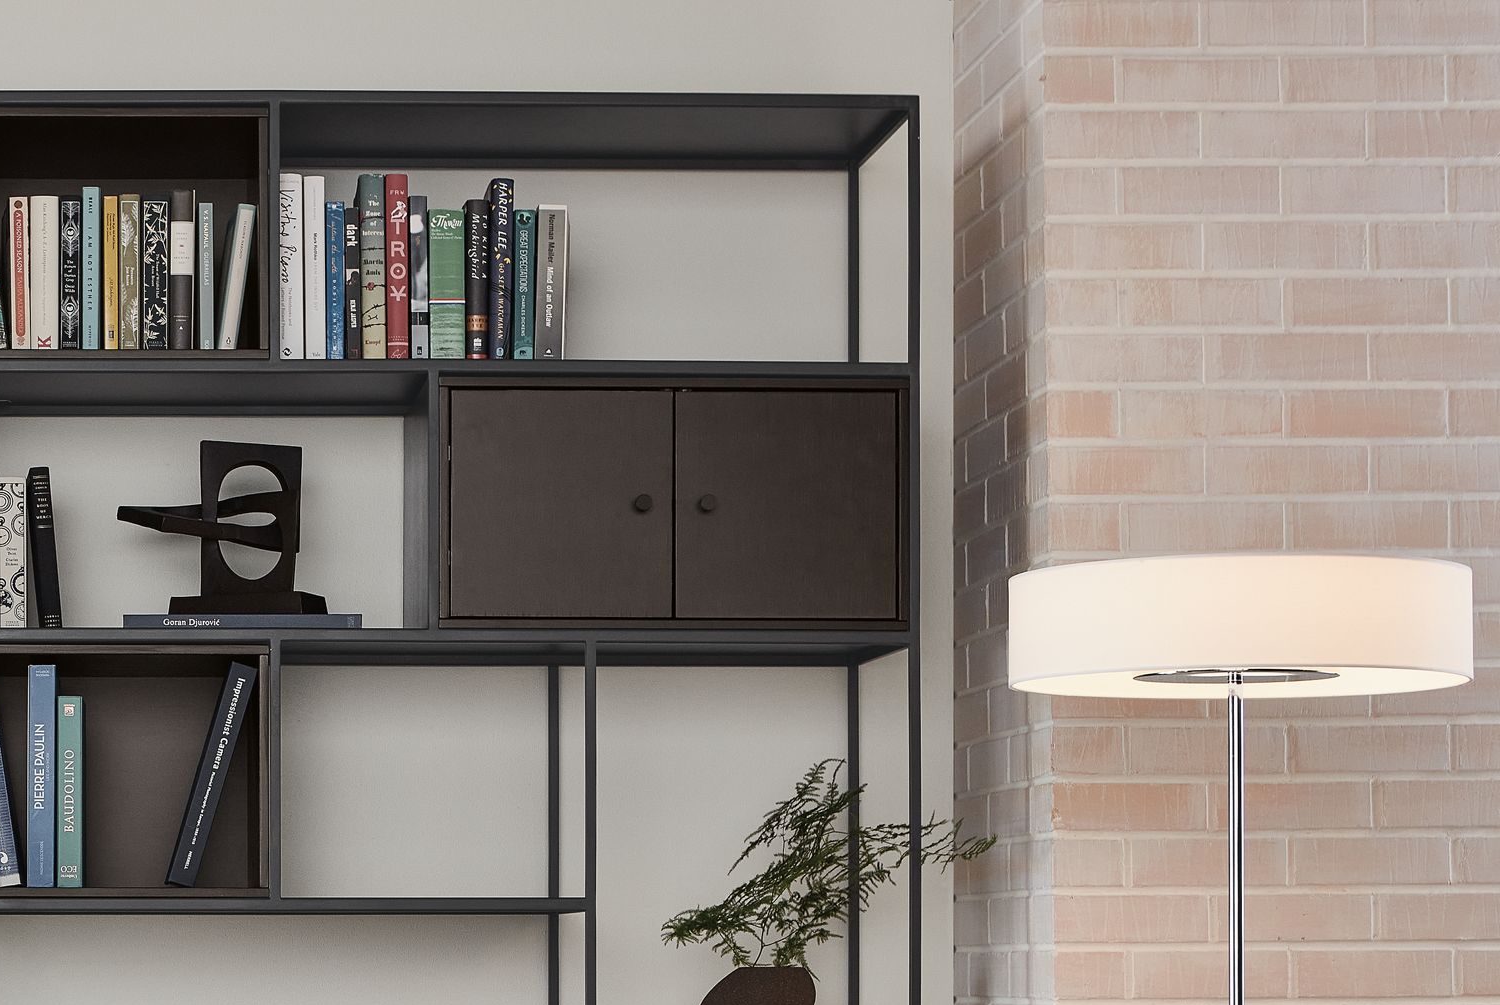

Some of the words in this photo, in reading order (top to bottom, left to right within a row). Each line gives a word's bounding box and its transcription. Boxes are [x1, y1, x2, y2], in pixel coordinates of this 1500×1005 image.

[280, 189, 296, 236] Visiting
[498, 182, 507, 225] HARPER
[346, 224, 358, 246] dark
[468, 213, 480, 279] Mockingbird
[498, 231, 506, 250] LEE
[520, 230, 528, 250] GREAT
[280, 245, 297, 284] Picasso
[390, 219, 406, 301] TROY
[499, 263, 504, 273] GO
[519, 250, 528, 292] EXPECTATIONS
[545, 304, 553, 328] Outlaw
[546, 294, 552, 302] an
[496, 298, 504, 339] WATCHMAN
[163, 618, 186, 626] Goran
[188, 617, 220, 628] Djurović
[221, 677, 246, 735] Impressionist
[34, 724, 45, 764] PAULIN
[213, 737, 229, 769] Camera
[34, 767, 45, 810] PIERRE
[64, 749, 75, 833] BAUDOLINO
